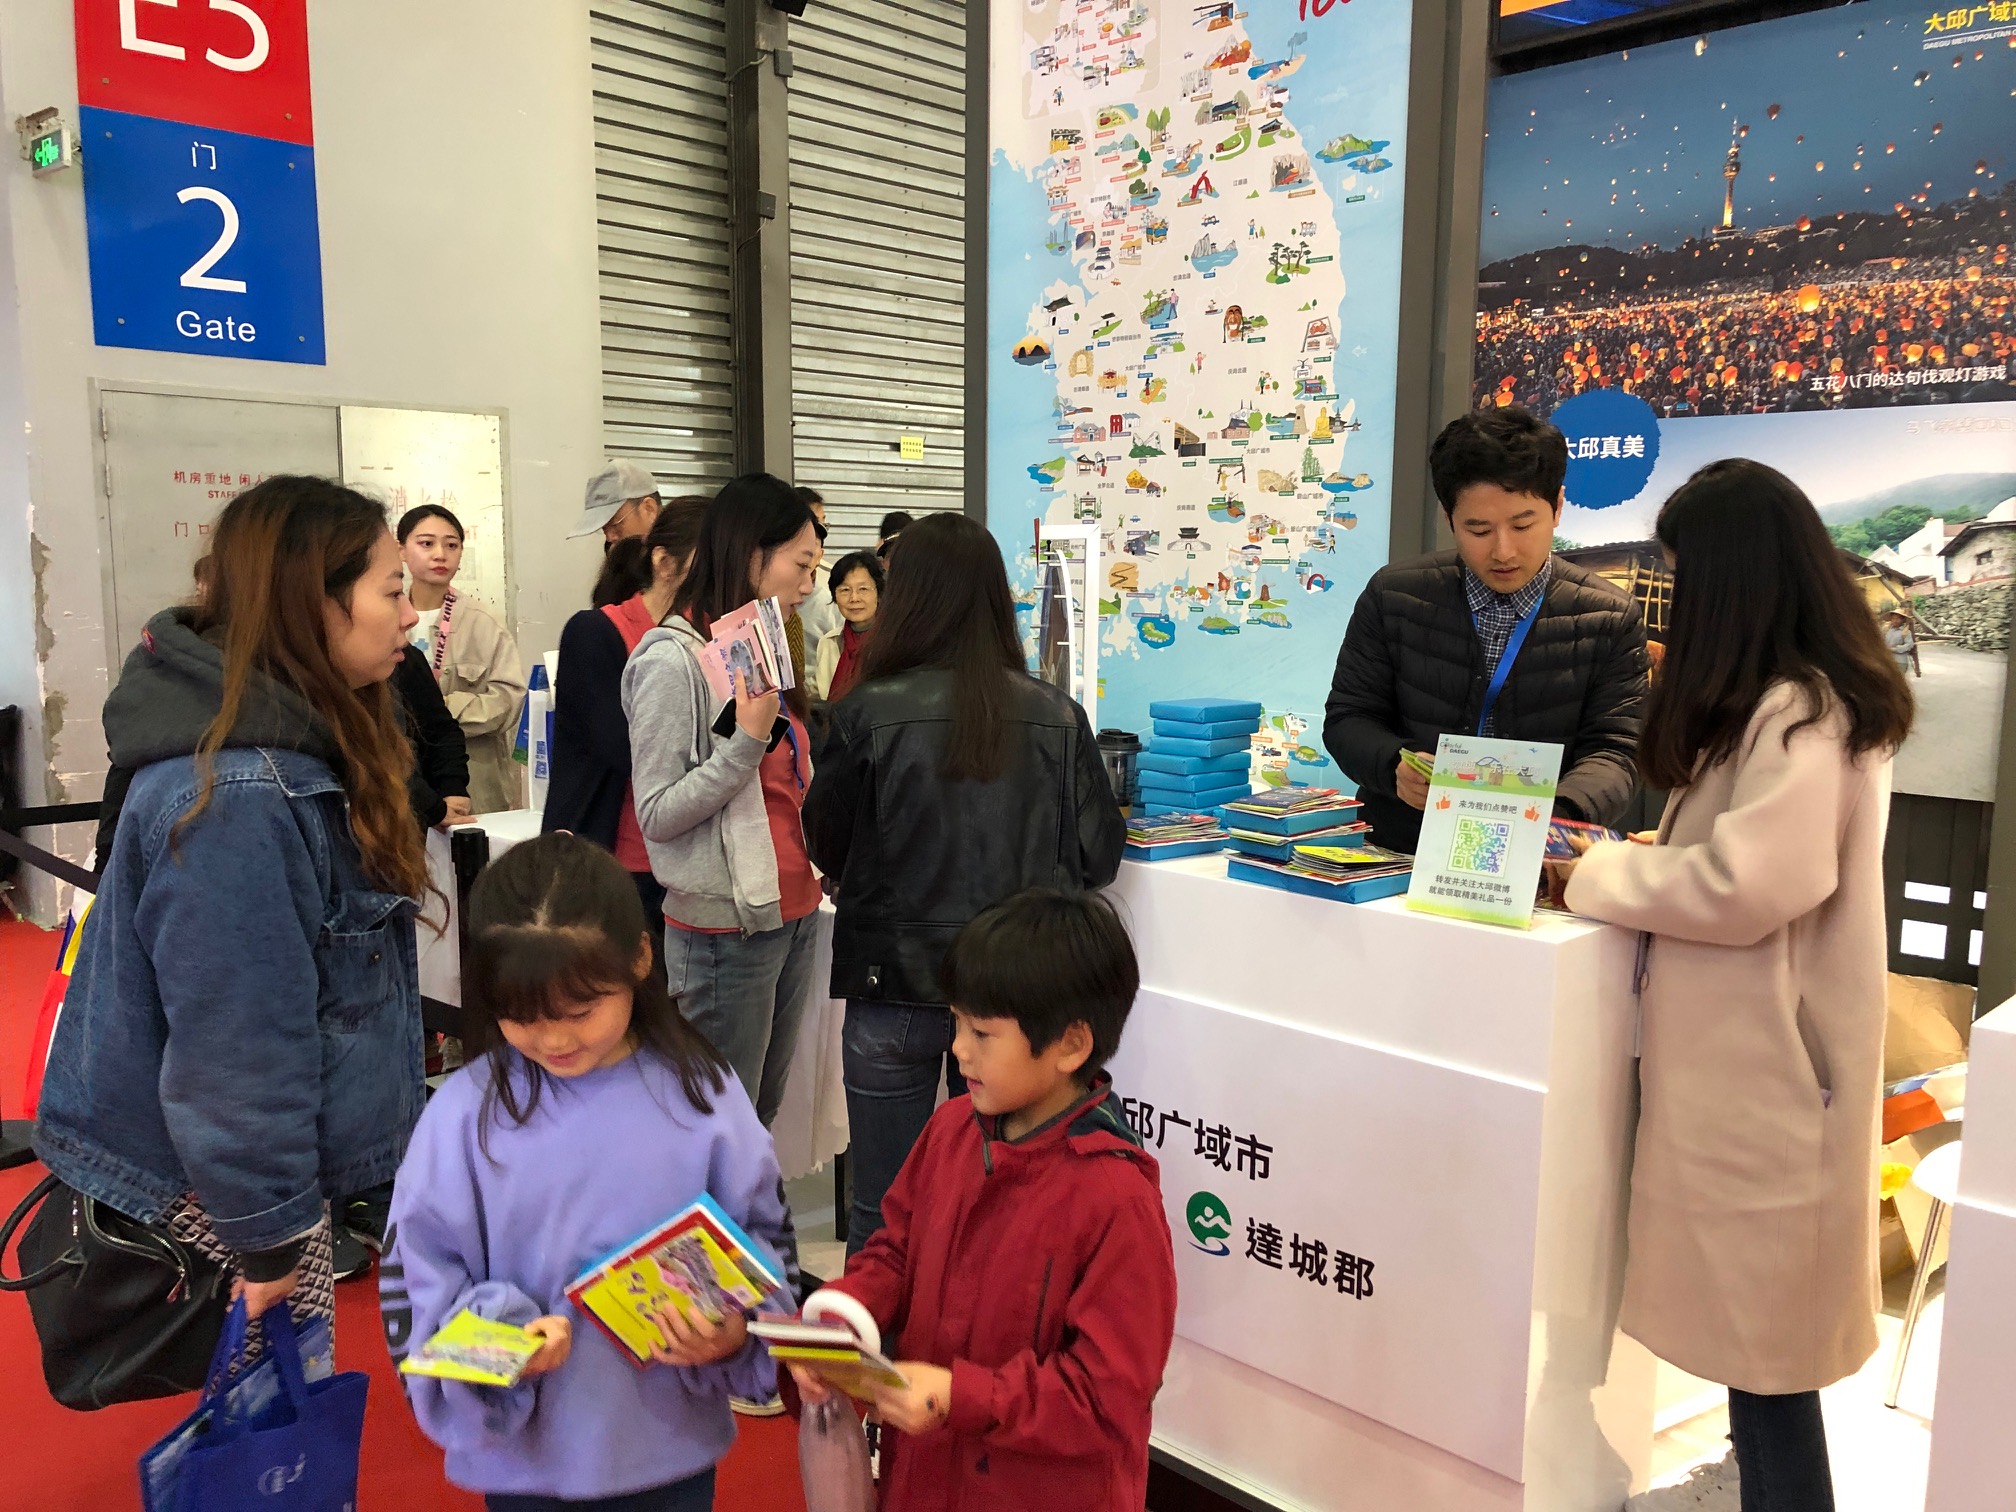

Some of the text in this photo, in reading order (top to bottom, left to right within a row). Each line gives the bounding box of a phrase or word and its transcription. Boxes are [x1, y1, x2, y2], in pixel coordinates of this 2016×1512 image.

[119, 0, 270, 72] E5
[191, 141, 217, 170] 门
[176, 186, 247, 294] 2
[176, 310, 256, 342] Gate
[1809, 364, 2007, 391] 五花八门的达句伐观灯游戏
[1565, 434, 1646, 460] 大邱真美
[173, 470, 232, 486] 机房重地
[1458, 799, 1518, 815] 来为我们点赞吧
[1428, 885, 1513, 906] 就能领取精美礼品一份
[1435, 874, 1511, 894] 转发并关注大邱微博
[1245, 1217, 1375, 1300] 達城郡
